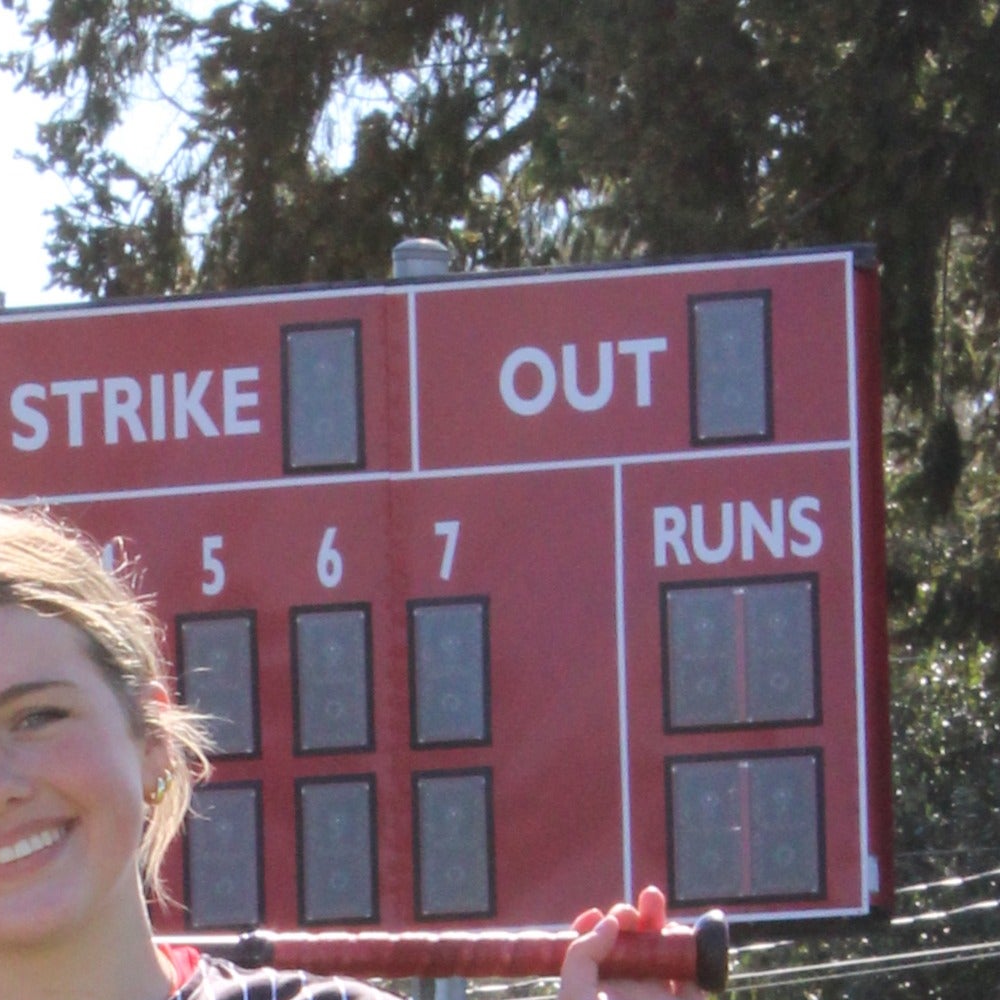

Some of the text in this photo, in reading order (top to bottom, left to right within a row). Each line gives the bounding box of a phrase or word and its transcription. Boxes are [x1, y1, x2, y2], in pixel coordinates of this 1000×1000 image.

[9, 365, 261, 452] STRIKE
[499, 336, 668, 417] OUT
[201, 535, 226, 596] 5
[316, 526, 344, 588] 6
[434, 519, 461, 581] 7
[652, 495, 823, 567] RUNS
